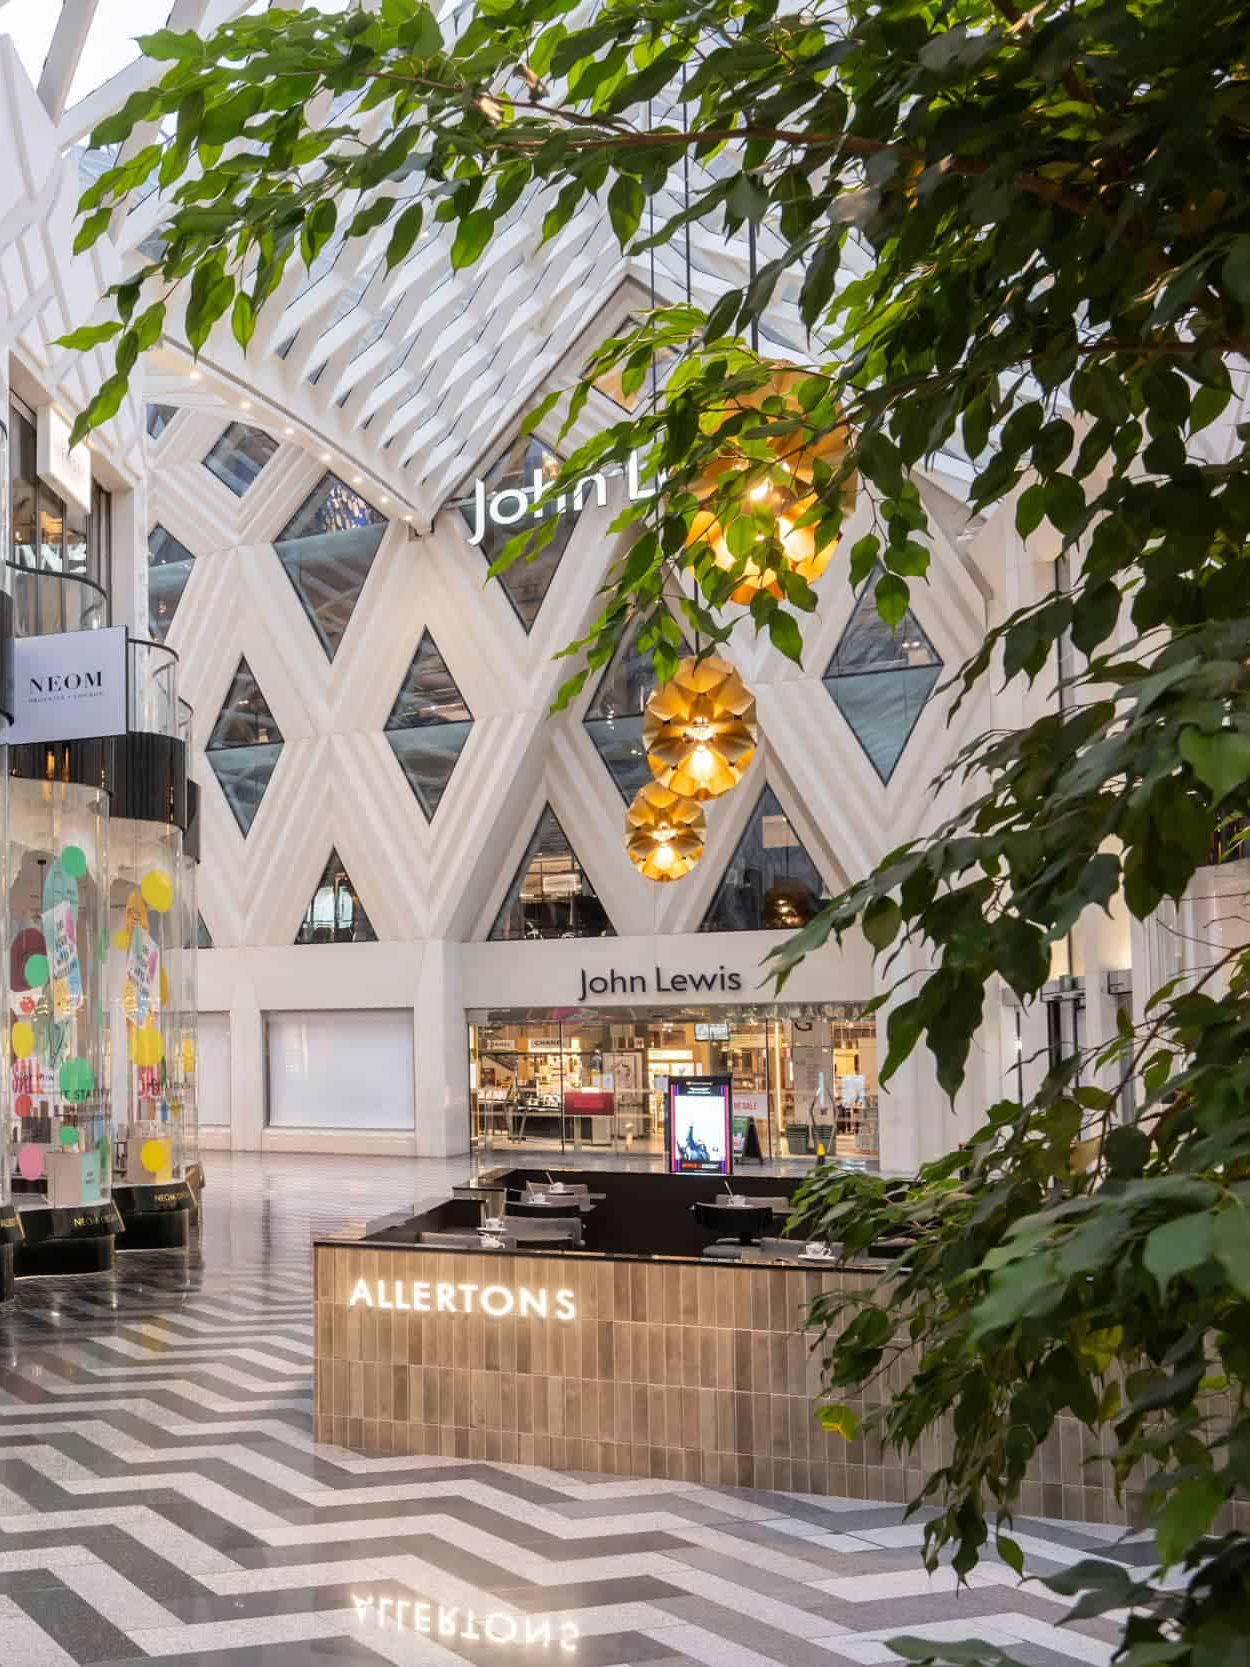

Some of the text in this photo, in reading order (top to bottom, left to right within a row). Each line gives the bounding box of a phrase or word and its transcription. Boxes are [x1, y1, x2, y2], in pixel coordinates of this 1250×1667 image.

[467, 466, 607, 547] John
[30, 671, 103, 692] NEOM
[578, 965, 742, 1002] John Lewis
[533, 1039, 565, 1048] CHANE
[349, 1277, 576, 1321] ALLERTONS
